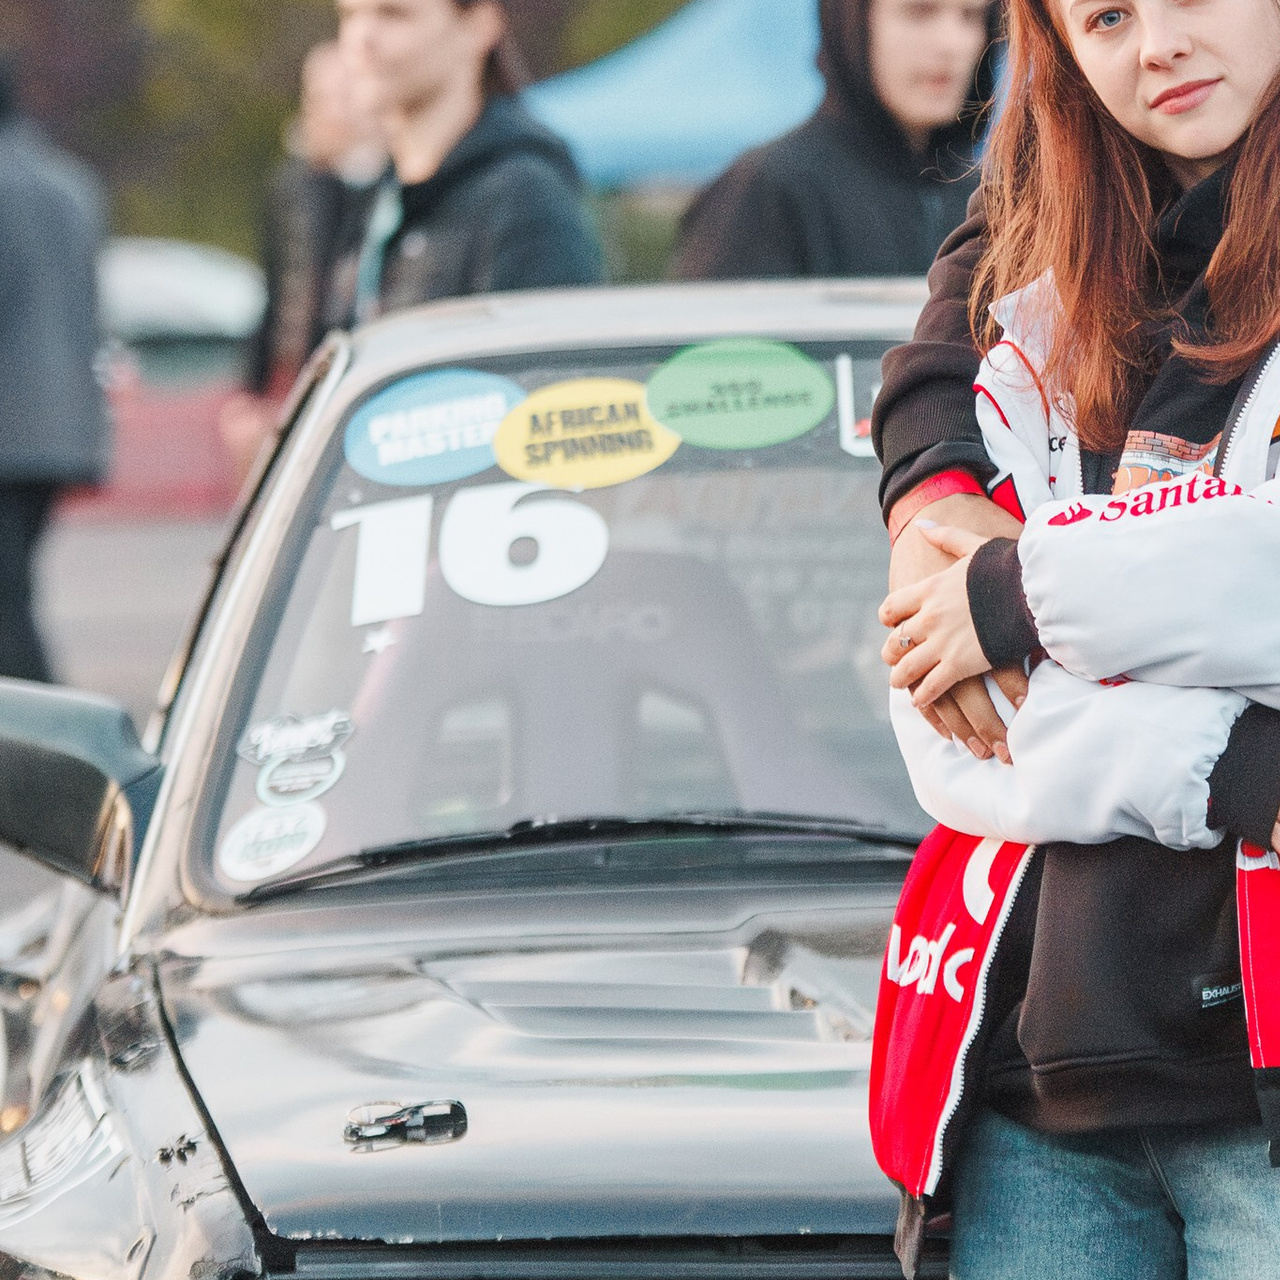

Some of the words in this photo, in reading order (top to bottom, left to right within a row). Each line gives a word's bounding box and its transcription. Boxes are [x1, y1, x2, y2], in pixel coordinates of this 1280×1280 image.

[529, 401, 640, 438] AFRICAN
[523, 428, 655, 469] SPINNING
[331, 482, 609, 627] 16
